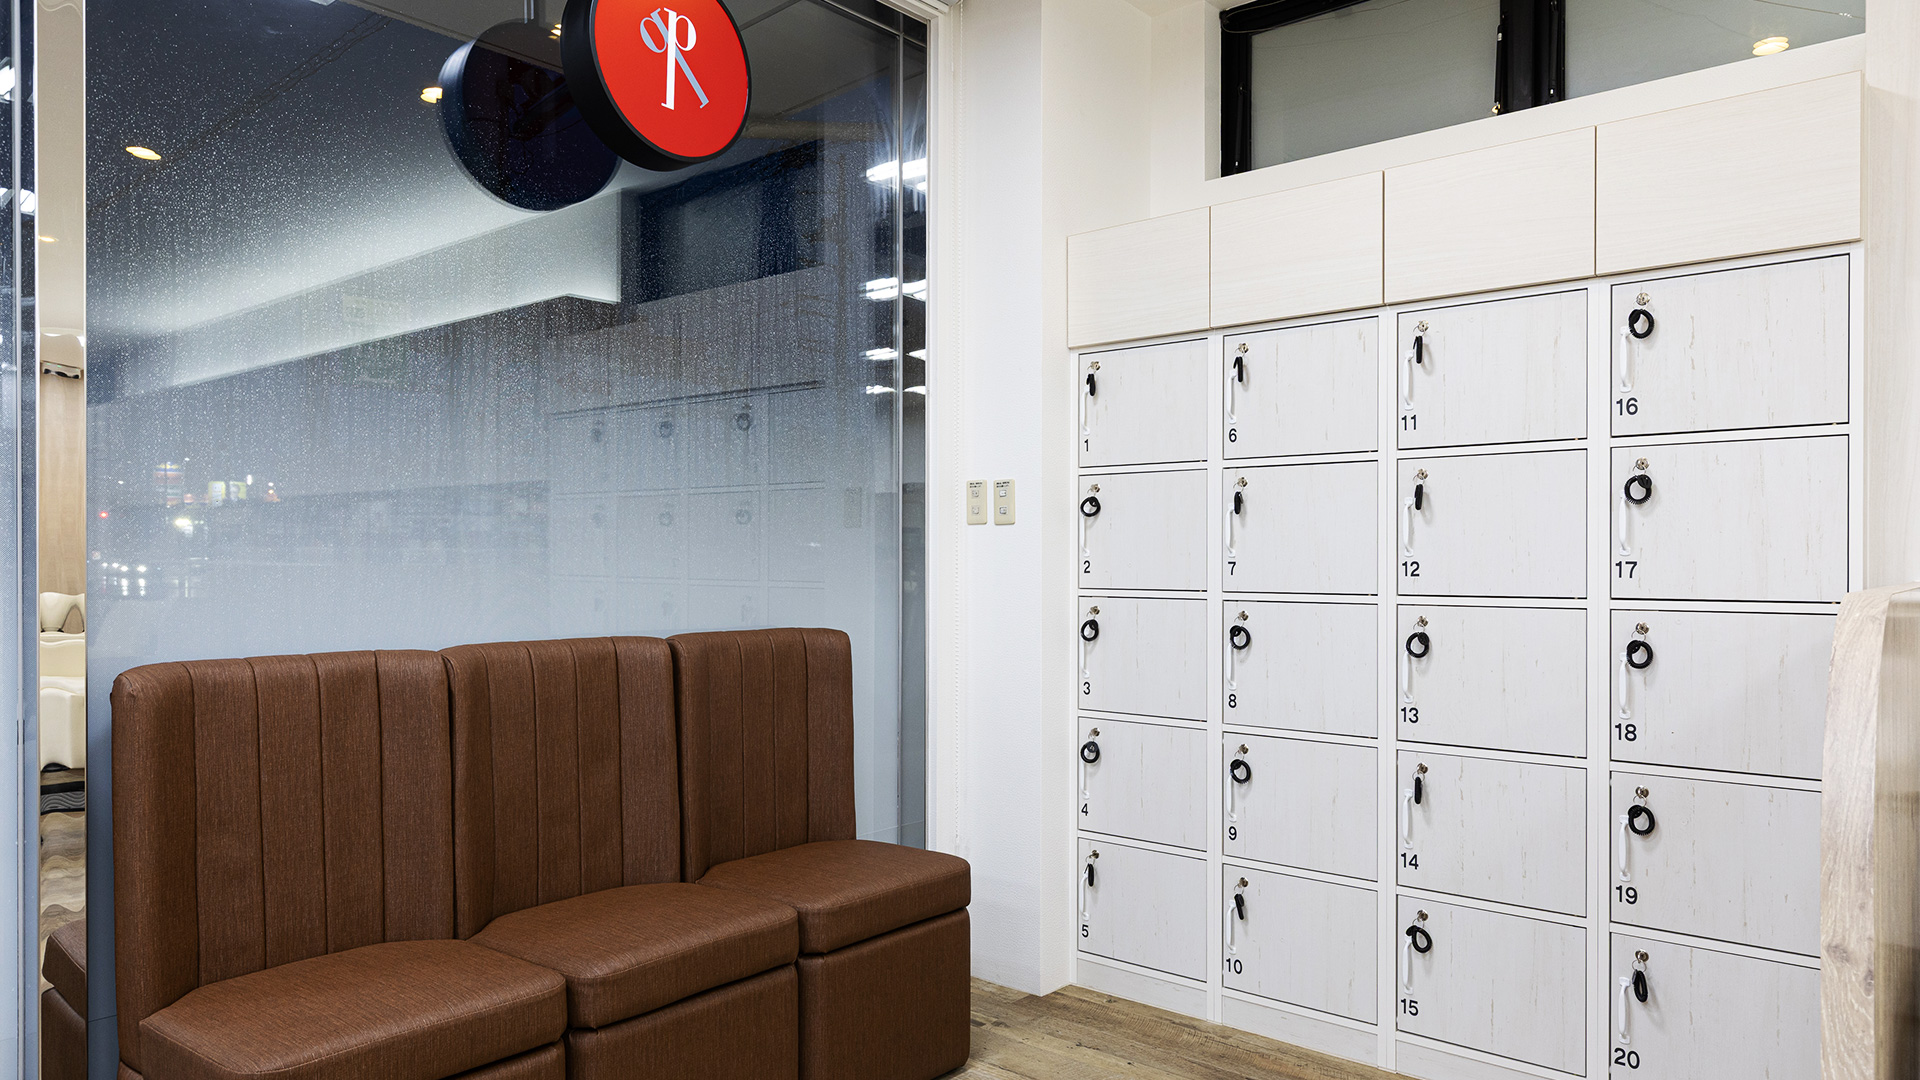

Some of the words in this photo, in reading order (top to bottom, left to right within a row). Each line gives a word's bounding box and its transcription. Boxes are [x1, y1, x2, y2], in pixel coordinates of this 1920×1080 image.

[1616, 397, 1639, 416] 16
[1401, 414, 1417, 431] 11
[1228, 427, 1238, 443] 6
[1083, 439, 1089, 452] 1
[1083, 560, 1091, 574] 2
[1227, 561, 1237, 576] 7
[1401, 560, 1420, 577] 12
[1615, 560, 1638, 579] 17
[1083, 681, 1091, 695] 3
[1228, 693, 1238, 709] 8
[1400, 706, 1420, 724] 13
[1614, 722, 1637, 742] 18
[1081, 802, 1089, 816] 4
[1228, 825, 1238, 841] 9
[1400, 852, 1420, 870] 14
[1615, 884, 1638, 905] 19
[1081, 923, 1089, 938] 5
[1225, 957, 1243, 975] 10
[1400, 998, 1420, 1017] 15
[1613, 1047, 1640, 1069] 20
